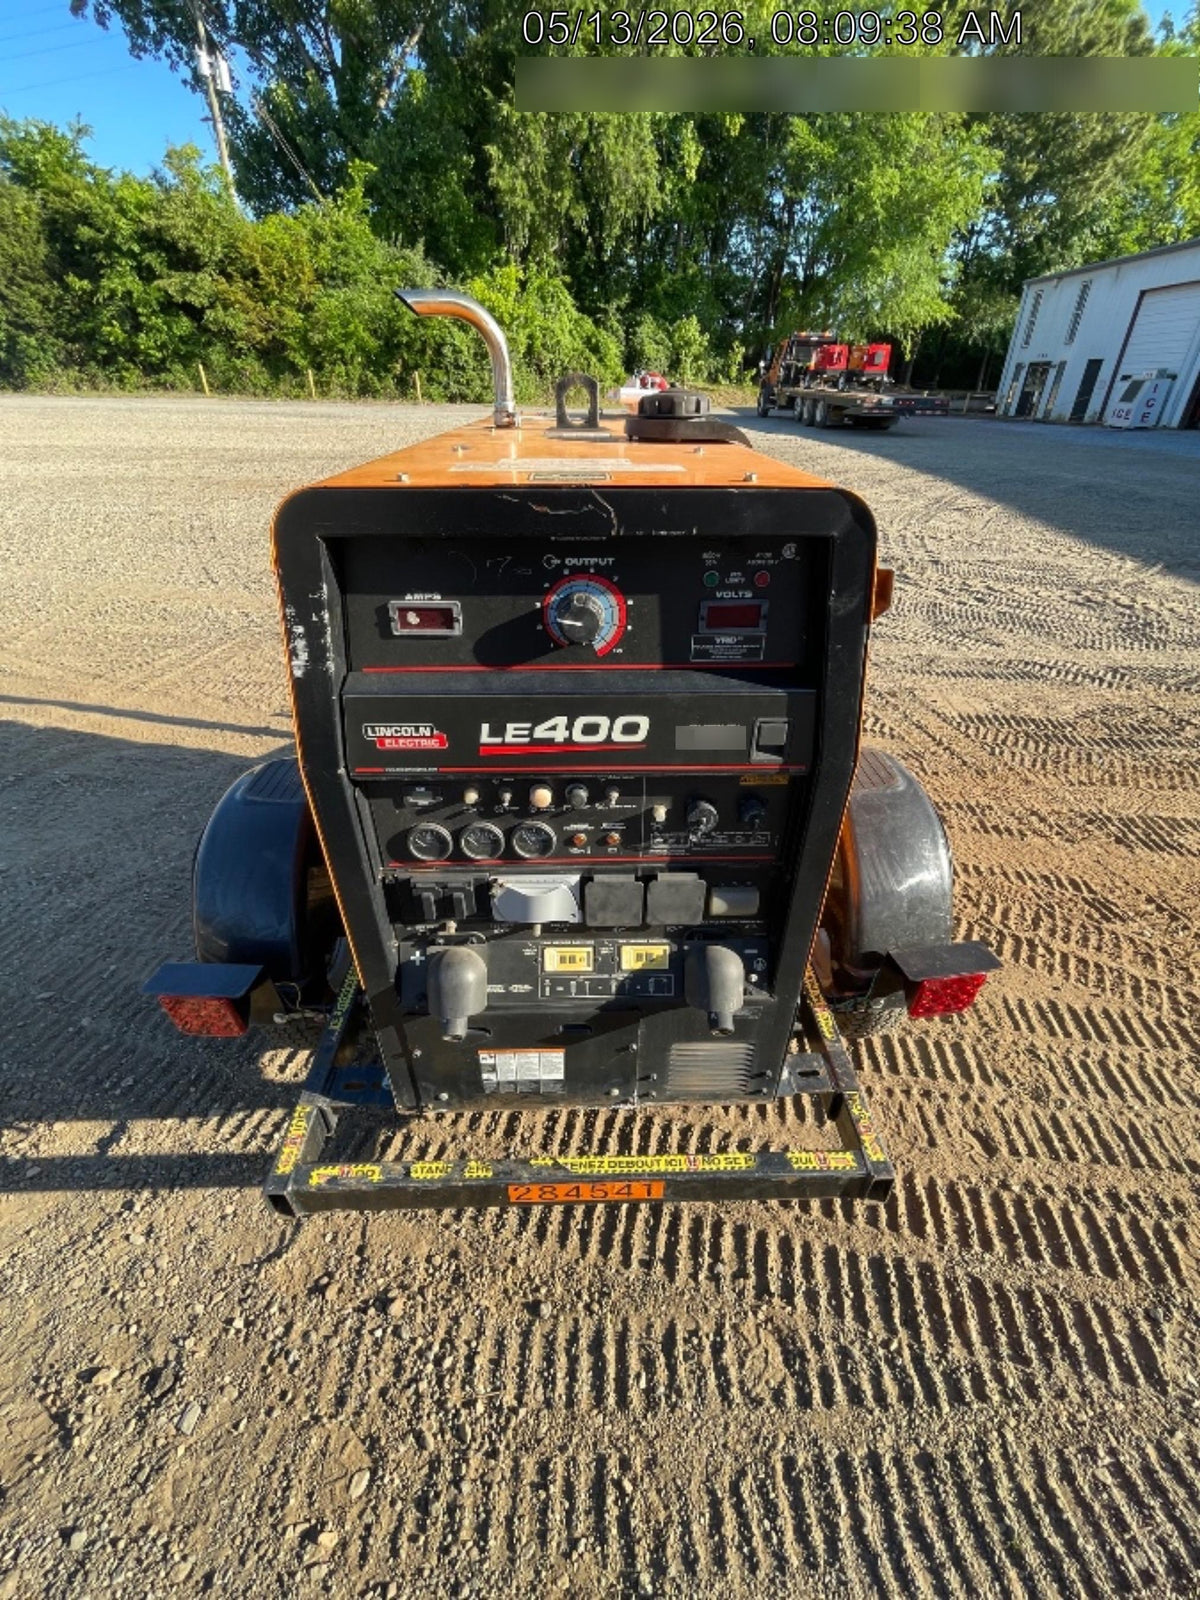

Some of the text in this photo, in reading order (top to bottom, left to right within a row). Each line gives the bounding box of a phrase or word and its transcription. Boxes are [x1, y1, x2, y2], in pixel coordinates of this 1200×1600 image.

[565, 557, 615, 566] OUTPUT
[715, 590, 753, 598] VOLTS
[367, 726, 431, 737] LINCOLN
[480, 715, 650, 743] LE400
[385, 738, 440, 748] ELECTRIC
[607, 1159, 662, 1169] DEBOUT
[664, 1157, 682, 1168] ICI
[701, 1156, 720, 1166] NO
[513, 1183, 654, 1201] 284541
